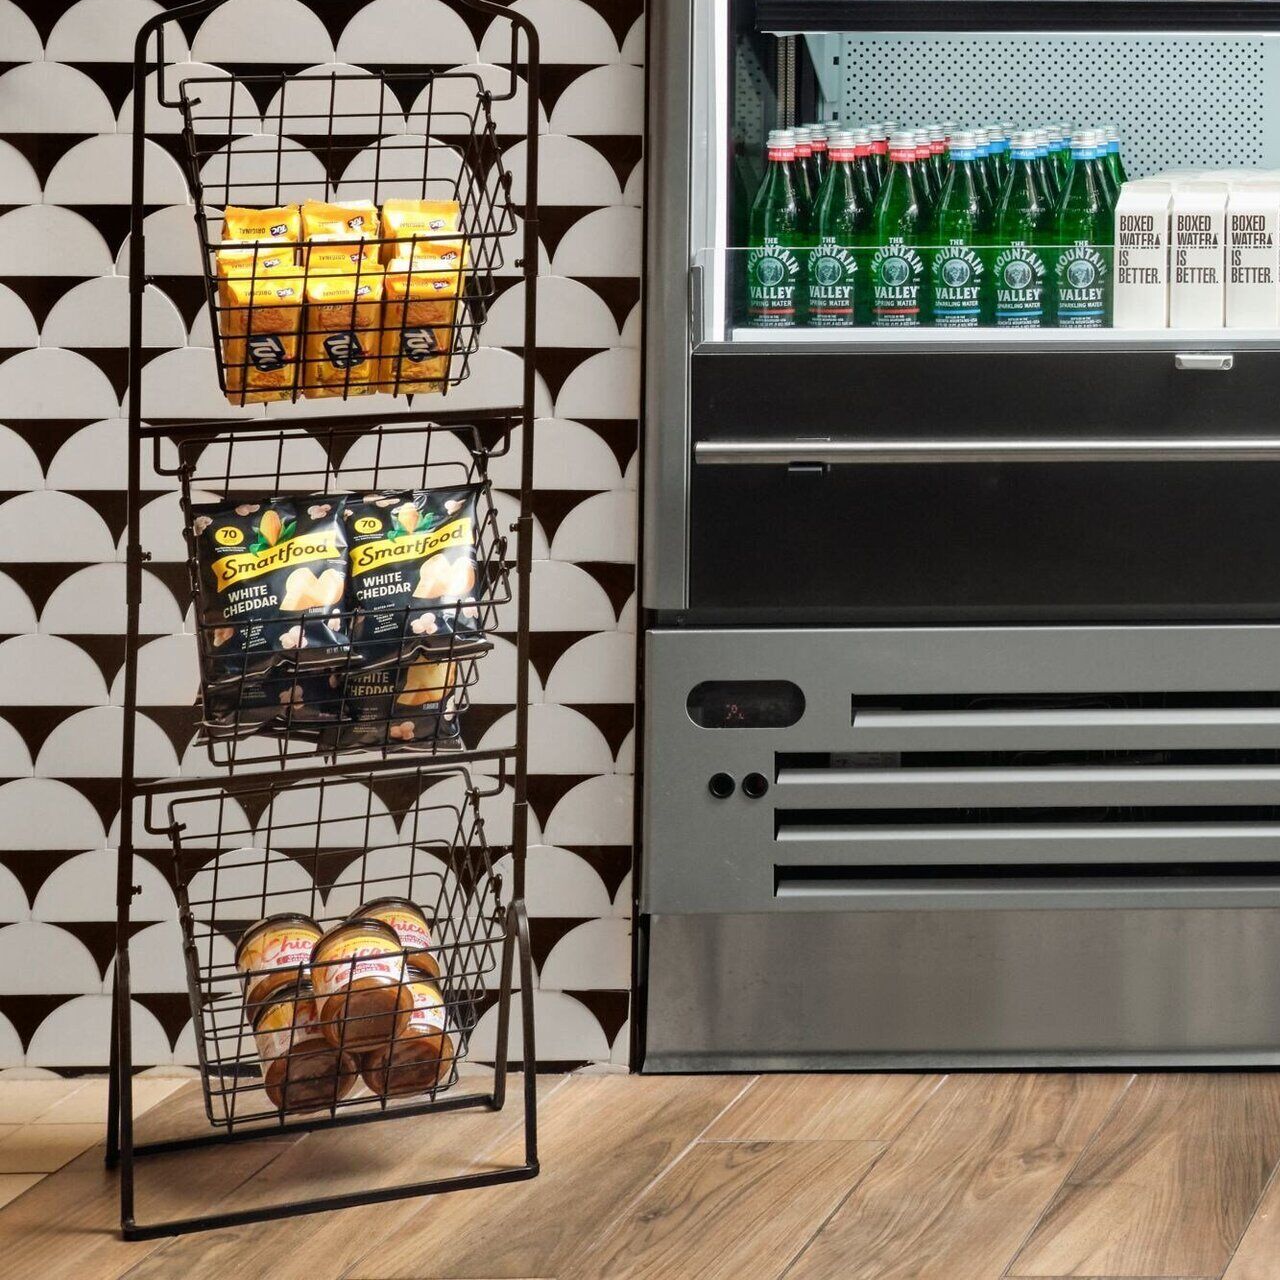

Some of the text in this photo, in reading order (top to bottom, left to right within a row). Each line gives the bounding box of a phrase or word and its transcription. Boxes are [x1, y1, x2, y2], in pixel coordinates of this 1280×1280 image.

[1120, 215, 1154, 231] BOXED
[1177, 215, 1211, 231] BOXED
[1232, 215, 1266, 231] BOXED
[747, 245, 800, 275] MOUNTAIN
[808, 245, 858, 274] MOUNTAIN
[871, 245, 924, 275] MOUNTAIN
[1119, 250, 1128, 266] IS
[1176, 250, 1186, 266] IS
[1231, 250, 1241, 266] IS
[1118, 267, 1161, 284] BETTER.
[1176, 267, 1219, 284] BETTER.
[1231, 267, 1273, 284] BETTER.
[750, 286, 795, 299] VALLEY
[810, 286, 852, 299] VALLEY
[874, 286, 920, 299] VALLEY
[936, 287, 980, 300] VALLEY
[997, 289, 1043, 302] VALLEY
[1060, 288, 1104, 301] VALLEY
[750, 300, 792, 308] SPRING WATER
[962, 301, 979, 309] WATER
[360, 520, 376, 529] 70
[221, 529, 237, 539] 70
[358, 525, 464, 567] Smartfood
[223, 540, 329, 581] Smartfood
[363, 572, 402, 588] WHITE
[228, 585, 268, 603] WHITE
[356, 583, 411, 600] CHEDDAR
[223, 596, 278, 619] CHEDDAR
